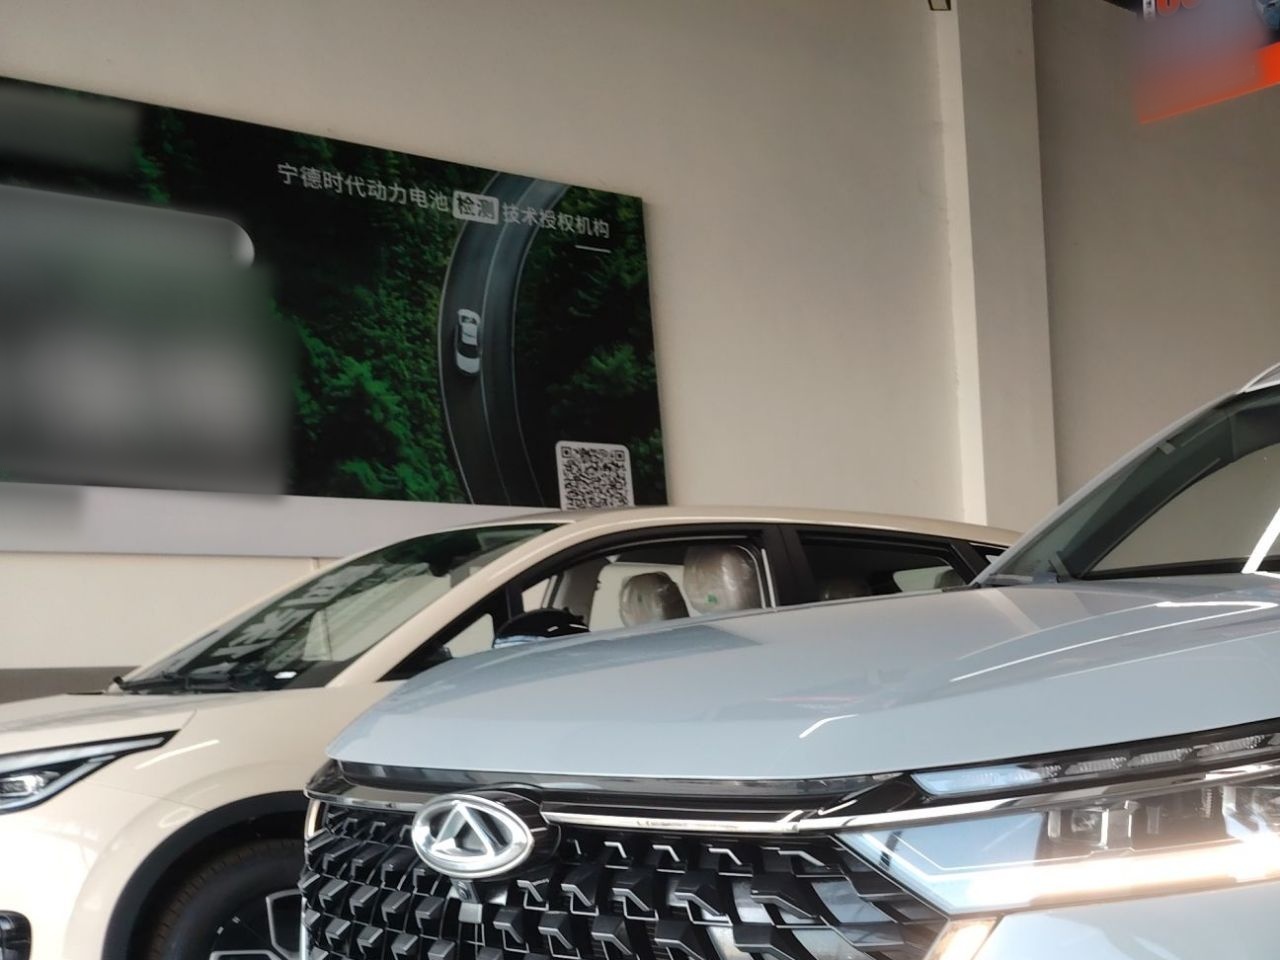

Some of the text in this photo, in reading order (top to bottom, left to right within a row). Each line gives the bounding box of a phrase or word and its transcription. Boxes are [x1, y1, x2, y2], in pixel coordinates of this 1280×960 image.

[277, 162, 449, 212] 宁德时代动力电池
[502, 203, 609, 239] 技术授权机构
